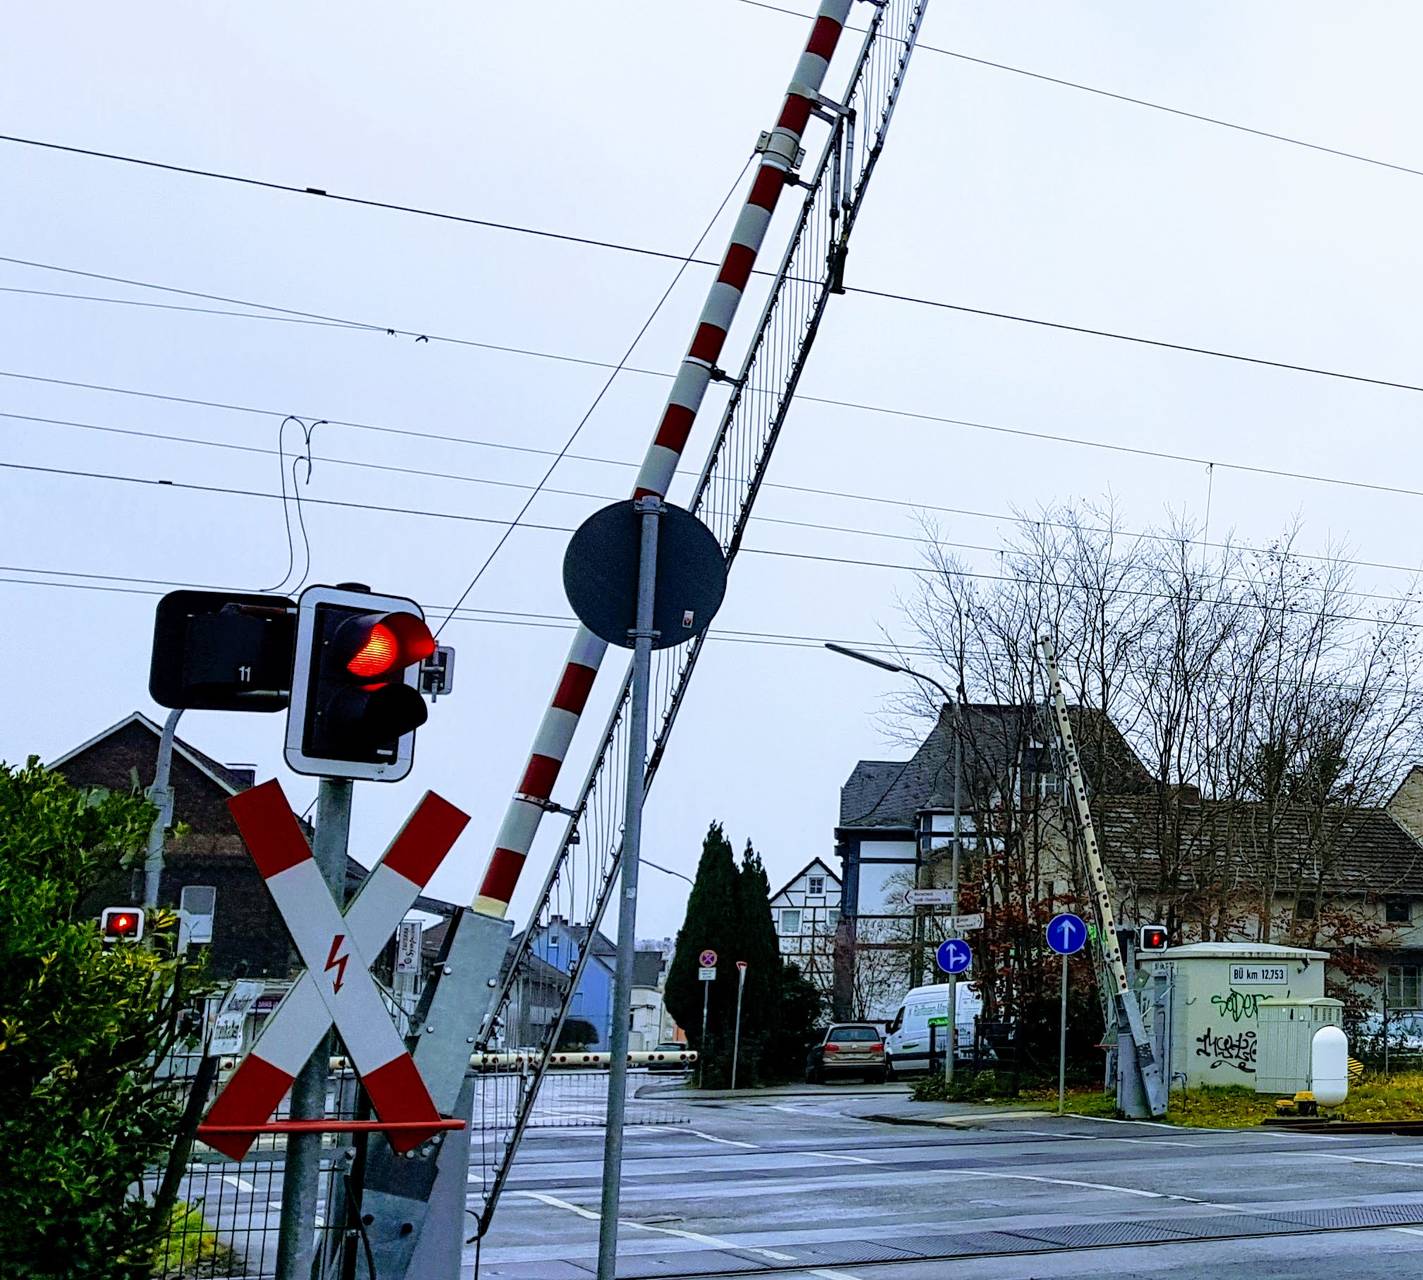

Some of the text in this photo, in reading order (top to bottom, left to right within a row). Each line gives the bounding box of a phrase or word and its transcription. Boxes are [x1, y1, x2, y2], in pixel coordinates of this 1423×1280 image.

[238, 665, 251, 682] 11
[1233, 967, 1244, 980] BÜ
[1246, 969, 1258, 980] km
